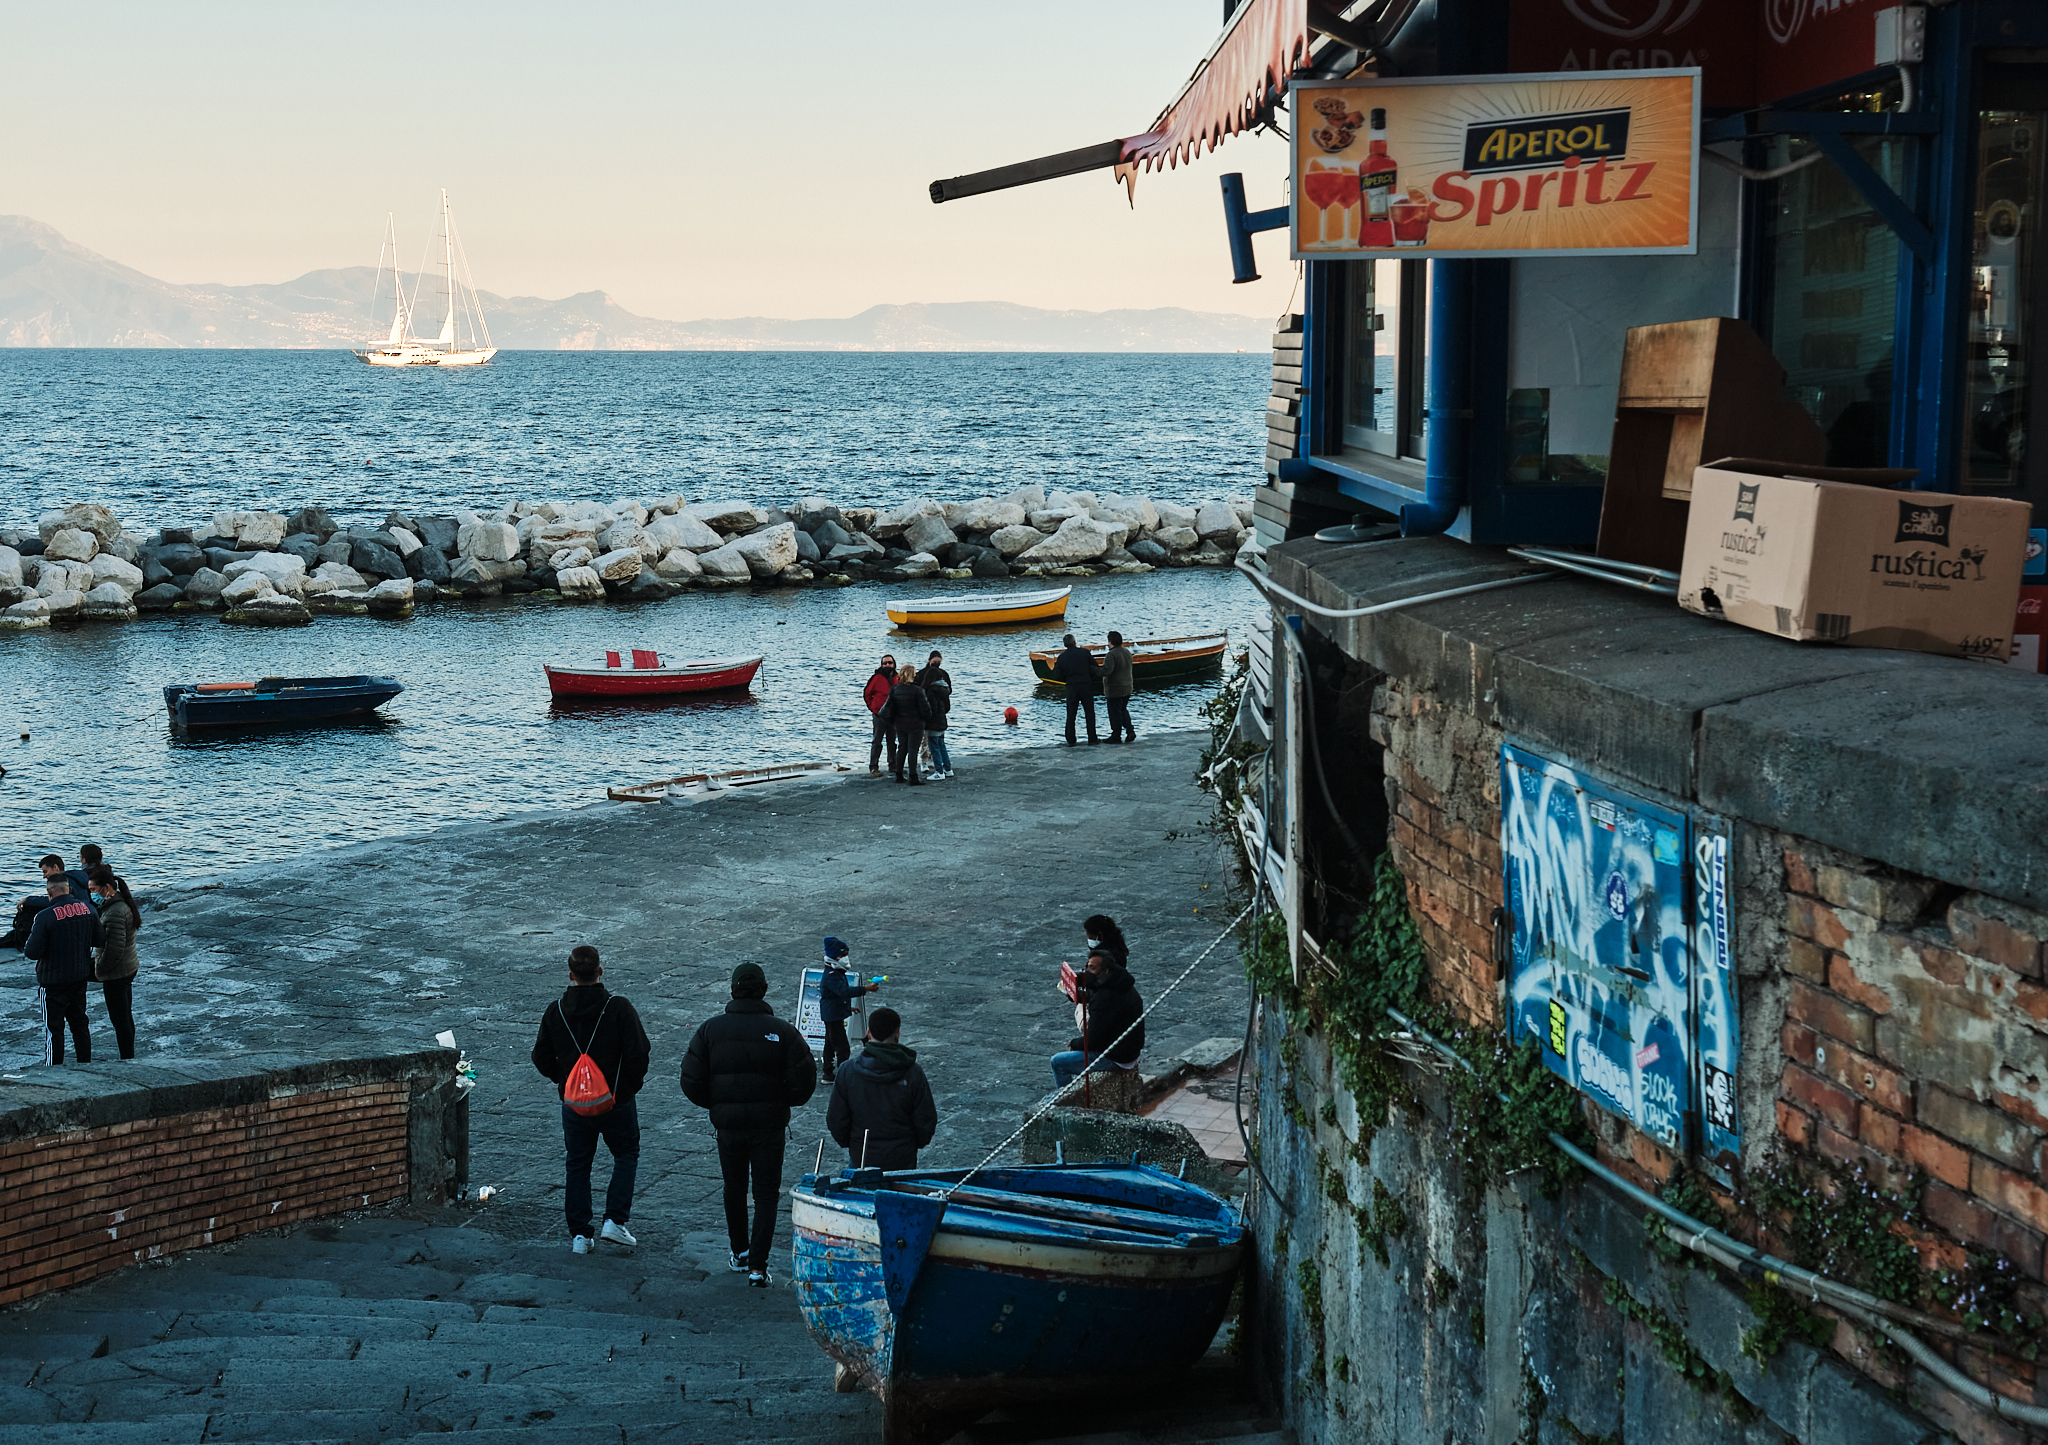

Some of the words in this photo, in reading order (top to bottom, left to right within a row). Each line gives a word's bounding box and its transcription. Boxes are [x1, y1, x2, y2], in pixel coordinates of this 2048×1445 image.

[1478, 124, 1610, 162] APEROL
[1362, 174, 1394, 188] APEROL
[1427, 156, 1657, 226] Spritz
[1720, 528, 1758, 555] rustica
[1870, 551, 1967, 580] rustica
[1958, 634, 2004, 655] 4497
